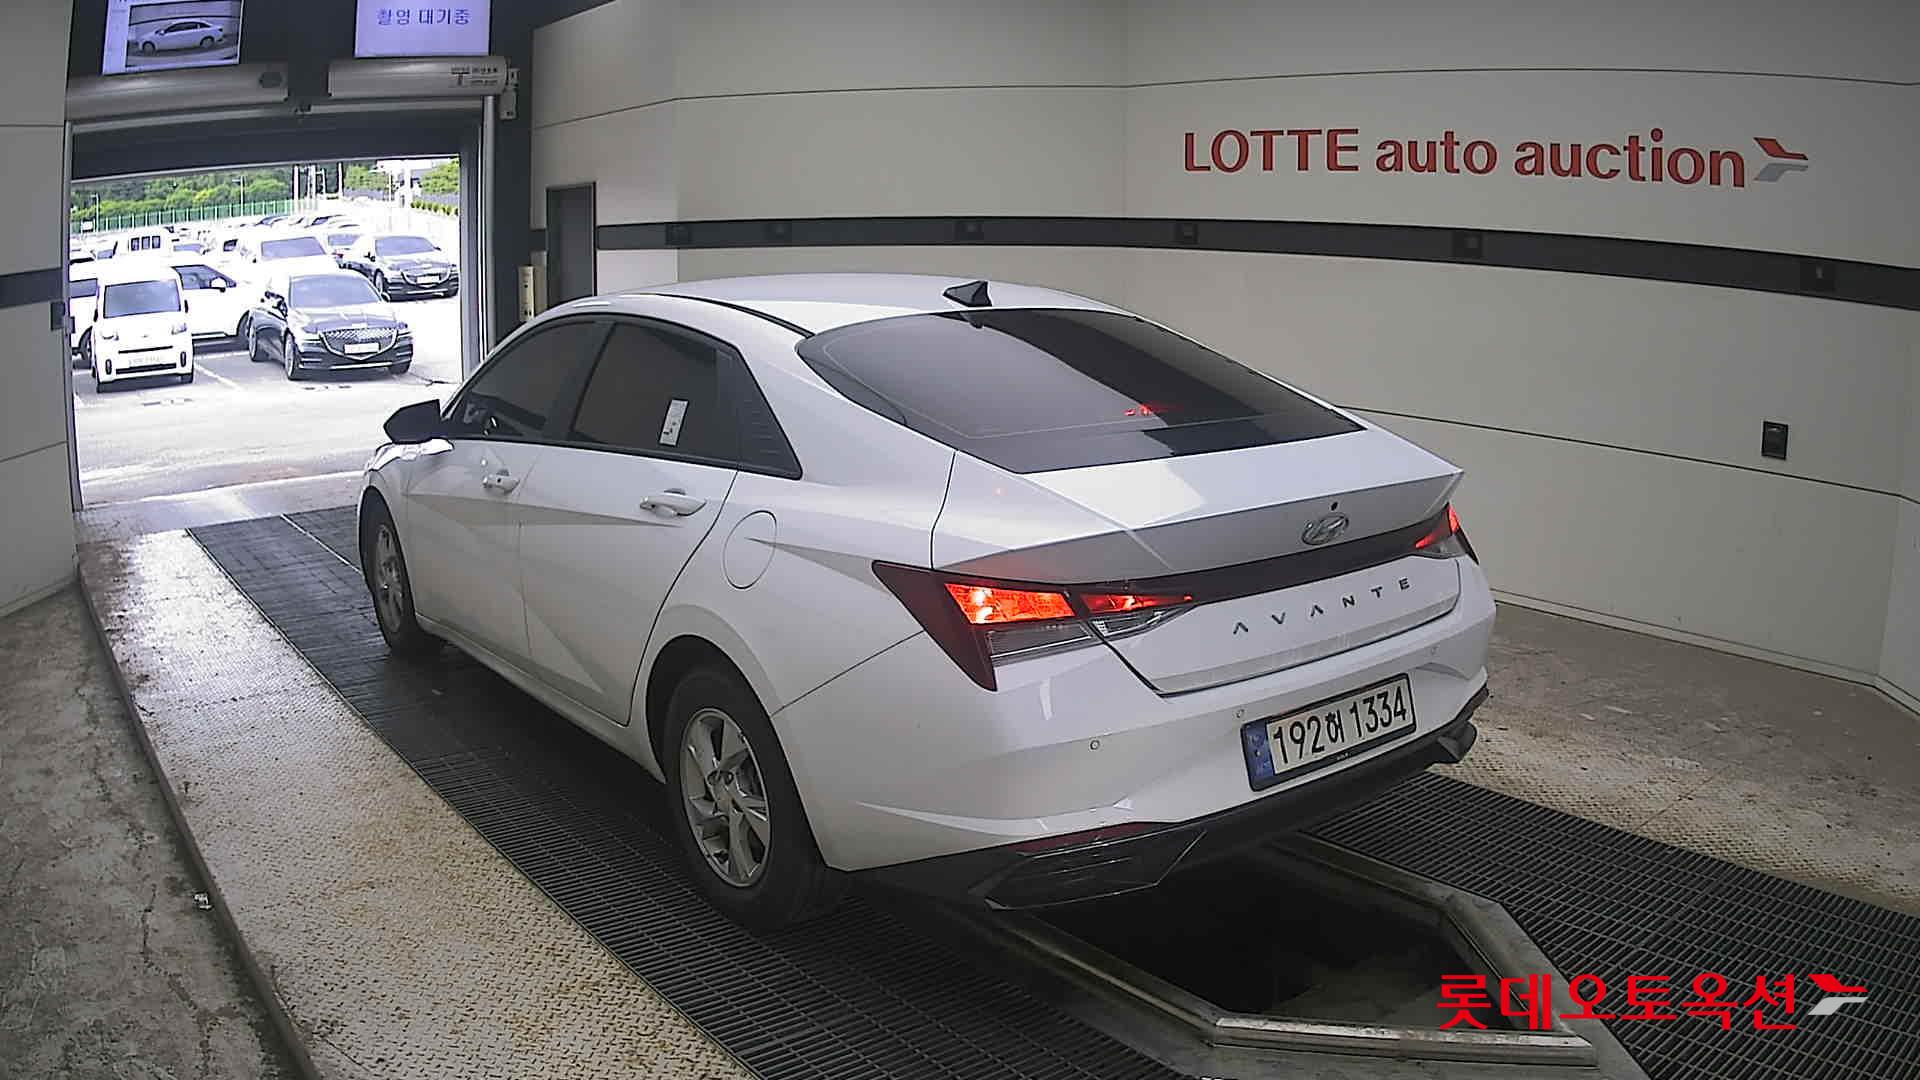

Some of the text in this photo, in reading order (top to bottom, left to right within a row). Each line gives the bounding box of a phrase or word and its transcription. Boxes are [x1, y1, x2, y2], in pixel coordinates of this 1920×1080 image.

[419, 8, 469, 25] 대기중
[1184, 128, 1745, 188] LOTTE auto auction
[1232, 578, 1410, 635] AVANTE
[1273, 686, 1407, 764] 192허 1334
